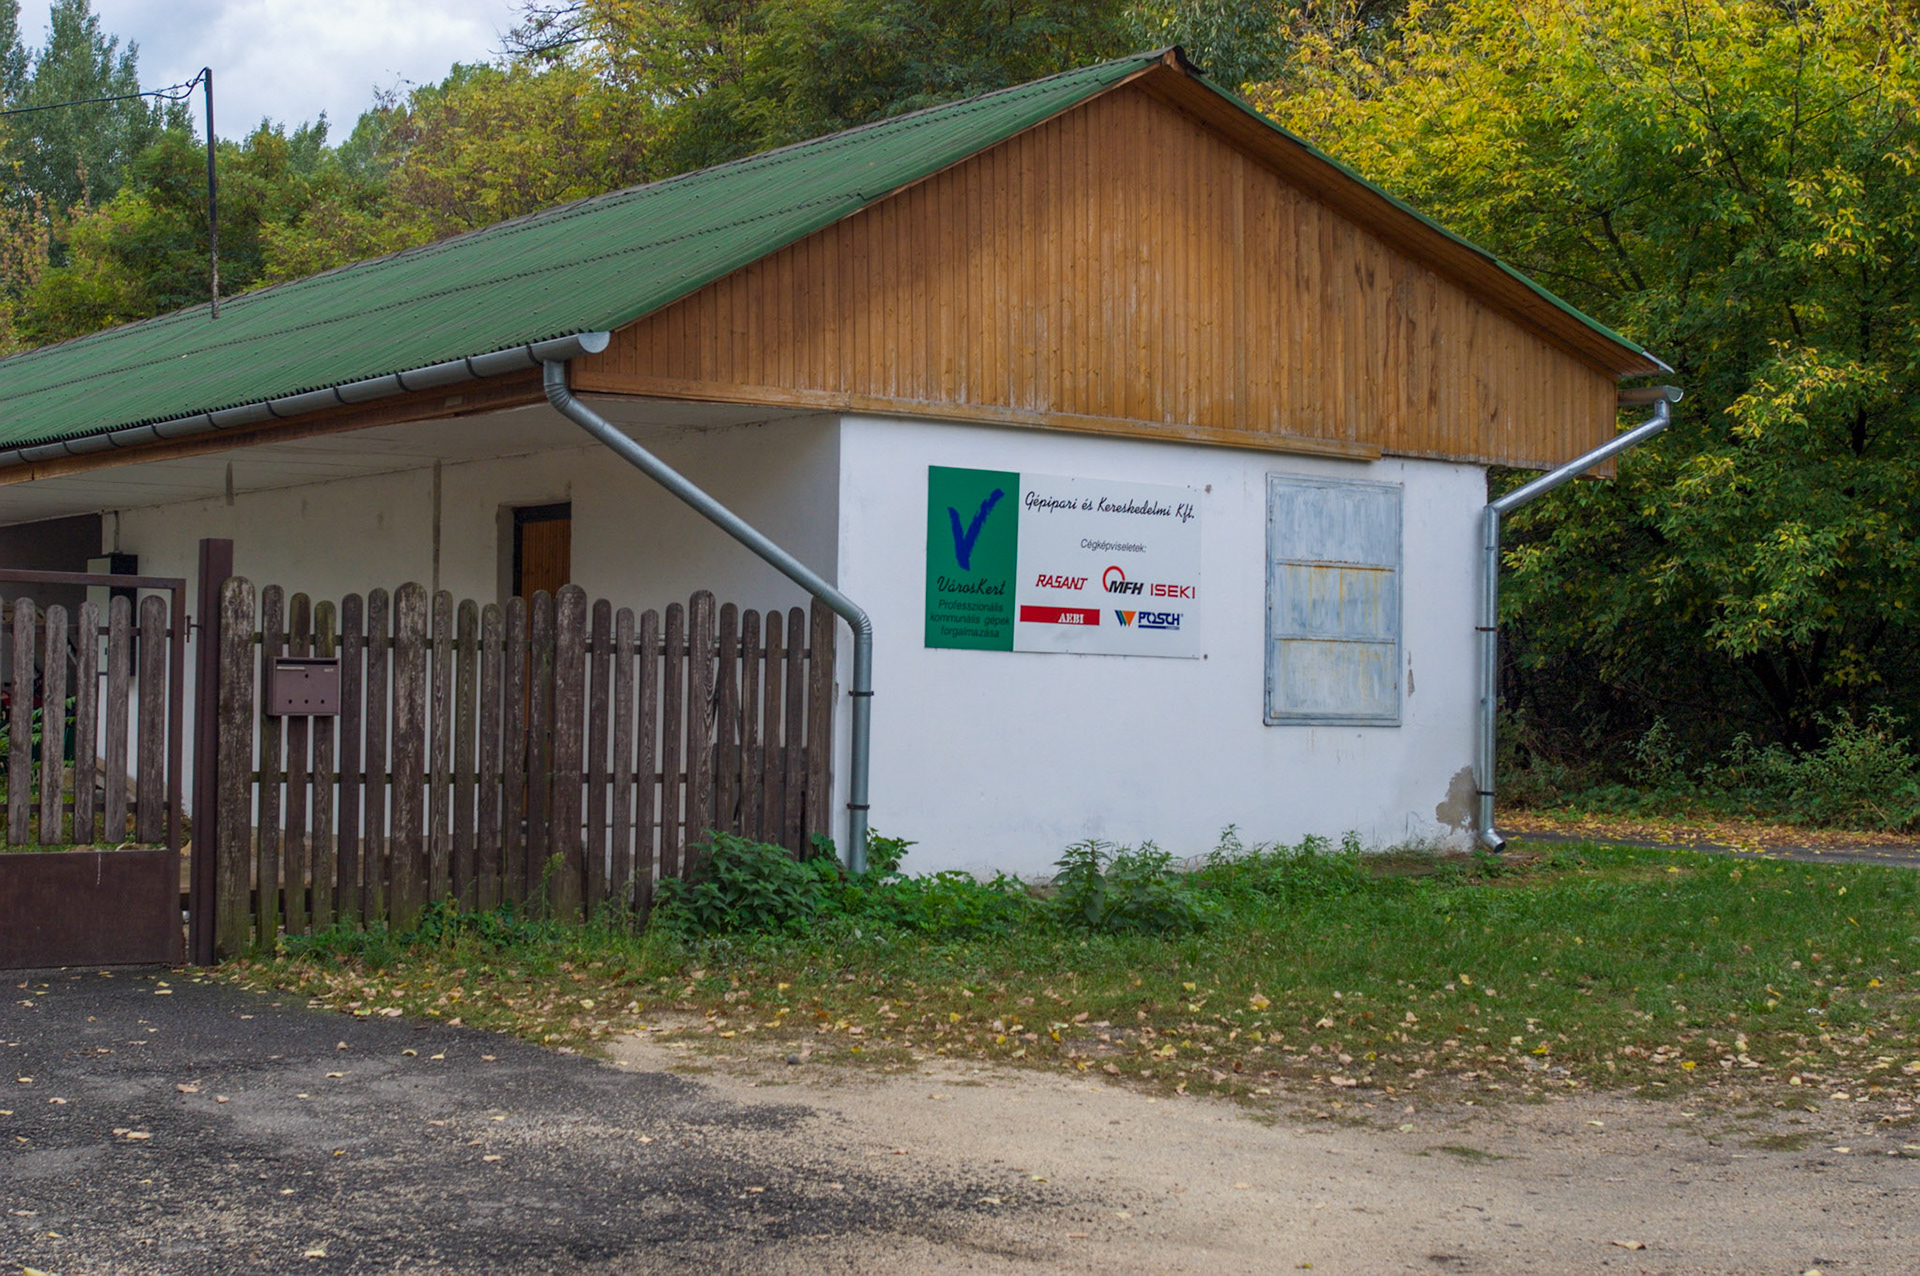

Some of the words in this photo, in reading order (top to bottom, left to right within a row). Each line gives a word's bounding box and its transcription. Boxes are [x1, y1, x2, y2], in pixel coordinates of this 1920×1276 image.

[1025, 491, 1077, 513] Gépipari
[1082, 499, 1093, 511] és
[1096, 497, 1171, 517] Kereskedelmi
[1175, 503, 1195, 523] Kft.
[1080, 538, 1147, 553] Cégképviseletek:
[937, 576, 1006, 595] VárosKert
[1035, 574, 1088, 590] RASANT
[1108, 581, 1144, 595] MFH
[1151, 583, 1196, 599] ISEKI
[938, 599, 1004, 613] Professzionális
[930, 612, 980, 624] kommunális
[984, 616, 1010, 627] gépek
[1058, 612, 1084, 624] AEBI
[1138, 611, 1180, 626] POSCH
[940, 626, 1000, 639] forgalmazása
